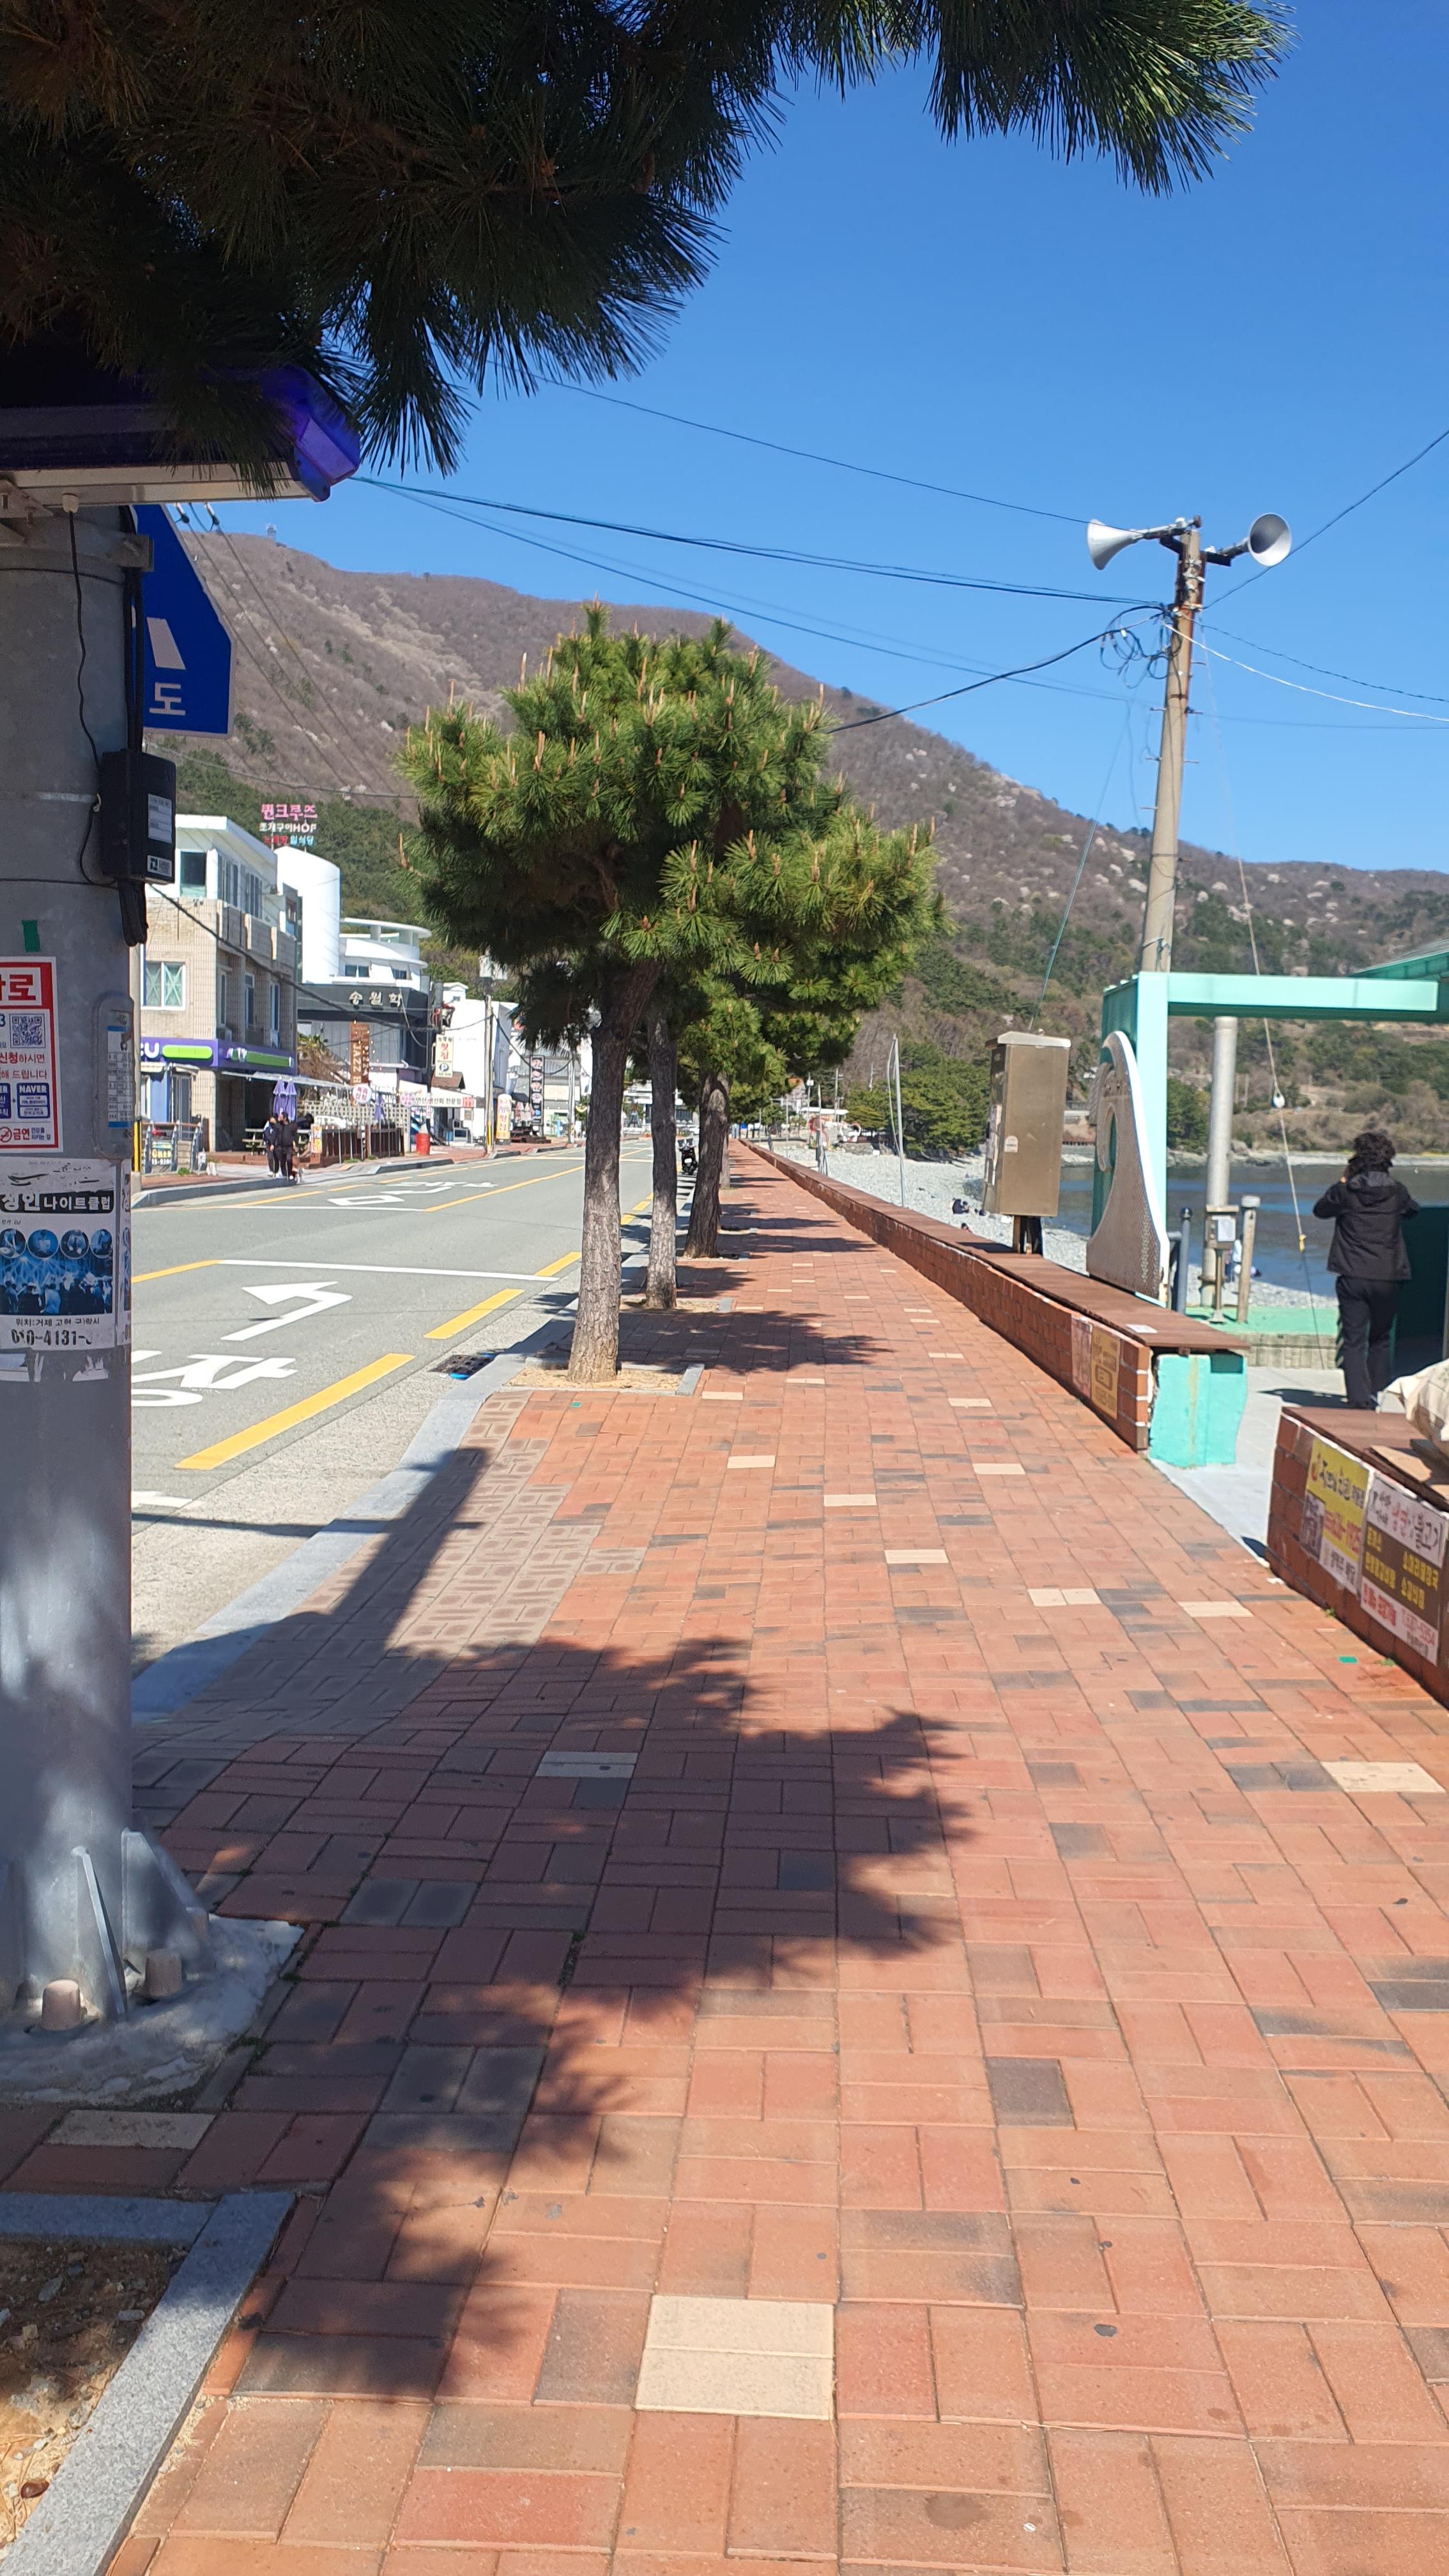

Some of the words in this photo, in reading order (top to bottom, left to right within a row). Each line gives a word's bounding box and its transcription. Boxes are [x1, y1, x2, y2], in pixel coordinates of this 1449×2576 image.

[141, 1042, 160, 1059] U
[353, 1043, 362, 1072] JAZZ
[0, 1069, 9, 1080] 해
[12, 1069, 47, 1080] 드립니다
[19, 1085, 47, 1093] NAVER
[13, 1128, 30, 1140] 금연
[131, 1349, 298, 1407] 장
